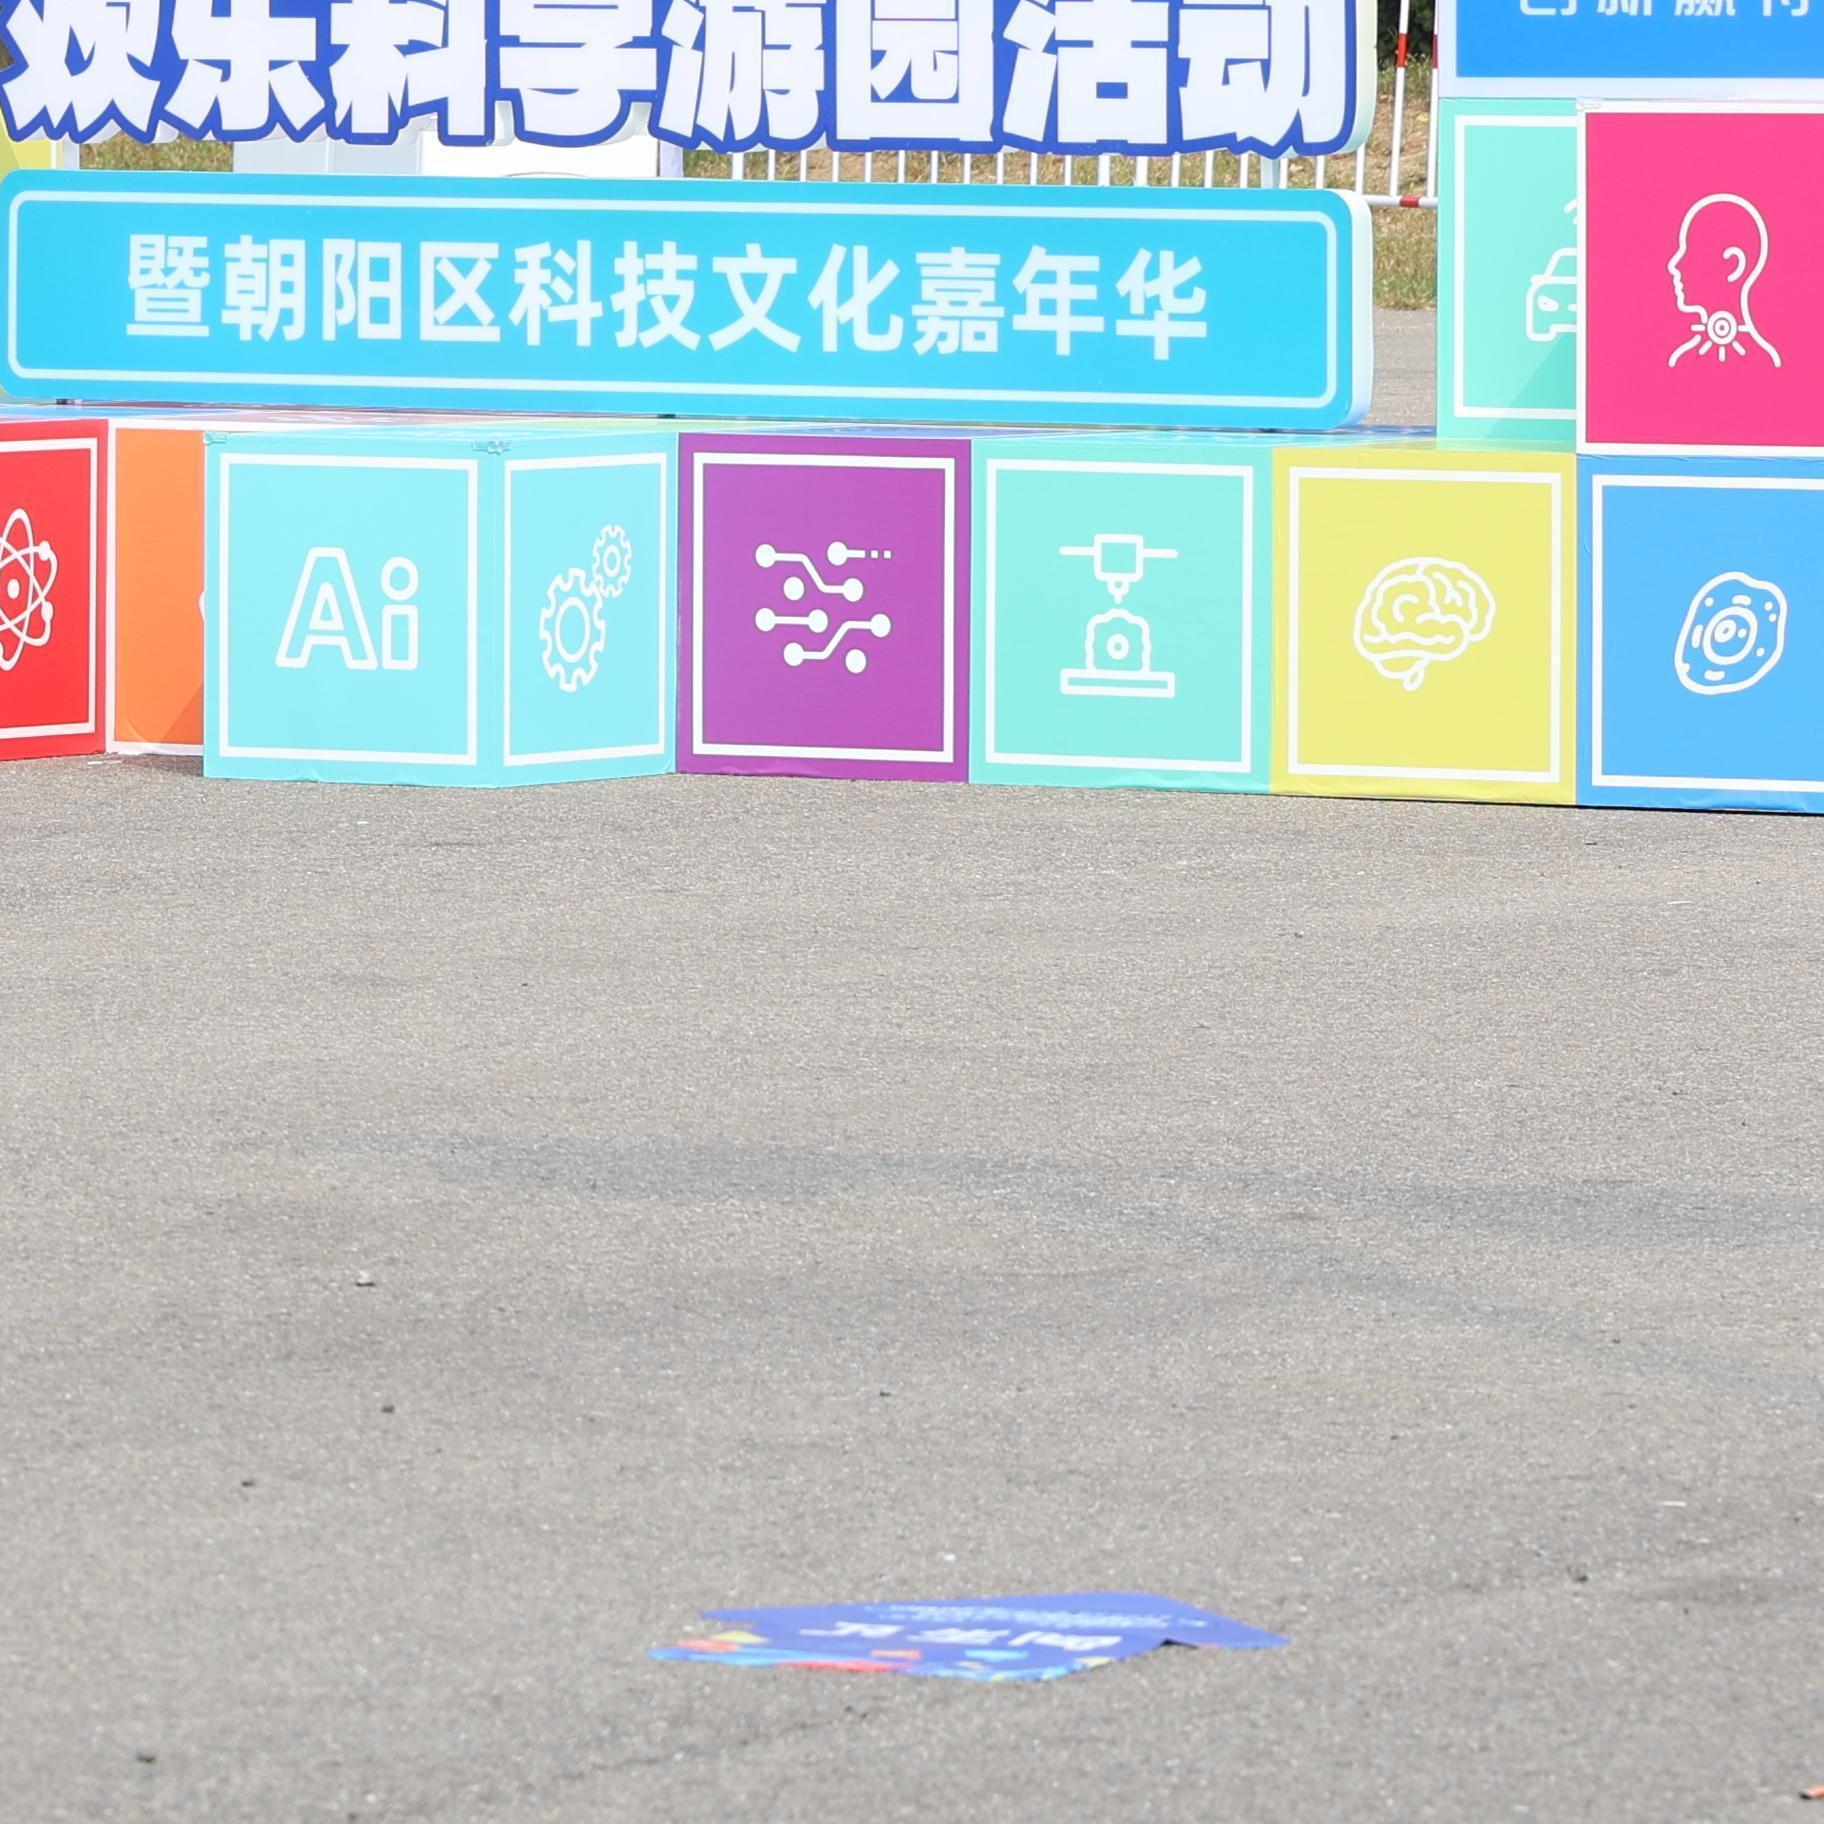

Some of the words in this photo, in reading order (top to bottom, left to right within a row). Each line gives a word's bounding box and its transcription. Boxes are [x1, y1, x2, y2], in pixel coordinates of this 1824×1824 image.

[125, 232, 1209, 362] 暨朝阳区科技文化嘉年华
[274, 545, 421, 672] Ai
